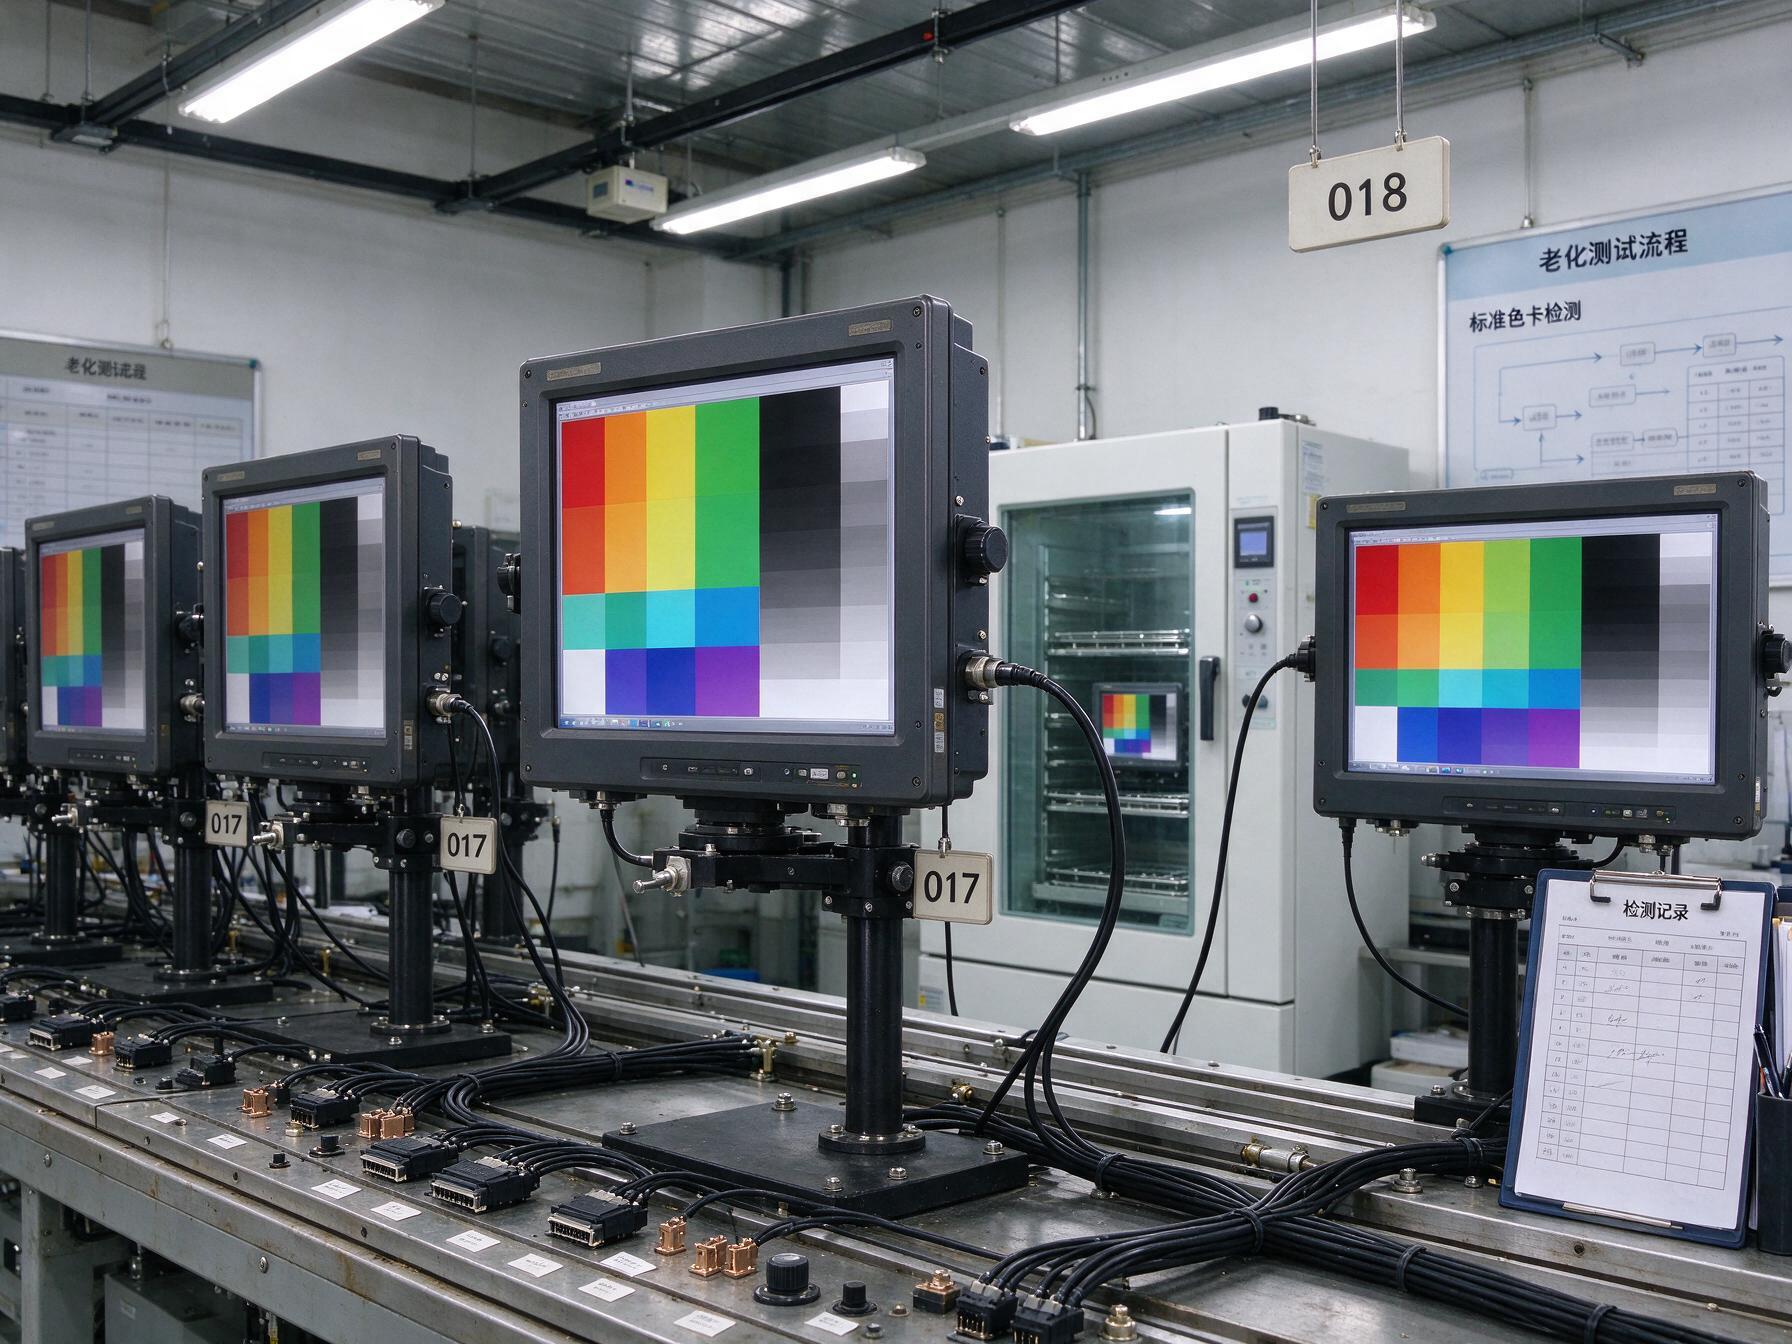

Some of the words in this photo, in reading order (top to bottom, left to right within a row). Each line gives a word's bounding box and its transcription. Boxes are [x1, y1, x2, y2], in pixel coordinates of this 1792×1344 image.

[1328, 172, 1407, 221] 018
[1539, 228, 1689, 273] 老化测试流程
[1469, 300, 1582, 333] 标准色卡检测
[211, 813, 242, 834] 017
[447, 832, 488, 858] 017
[924, 870, 980, 904] 017
[1622, 899, 1689, 922] 检测记录
